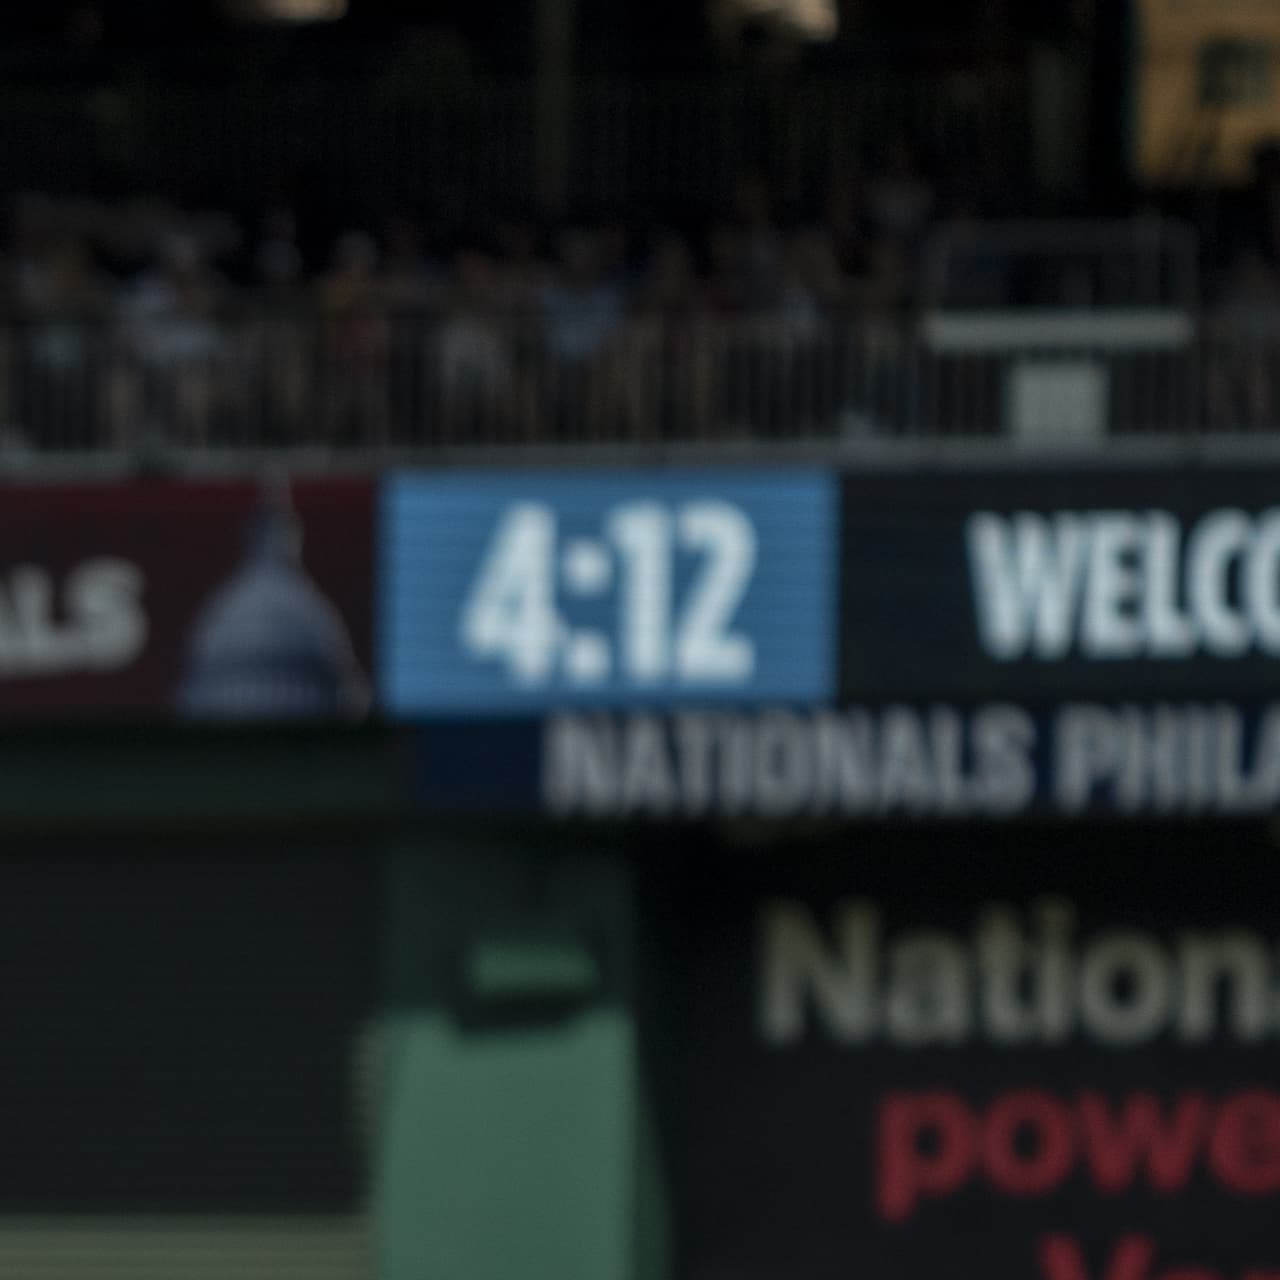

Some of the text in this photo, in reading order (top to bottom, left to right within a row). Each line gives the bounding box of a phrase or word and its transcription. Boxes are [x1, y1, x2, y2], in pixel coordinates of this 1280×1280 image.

[460, 499, 758, 686] 4:12
[540, 703, 1037, 818] NATIONALS
[757, 897, 1280, 1046] Nation
